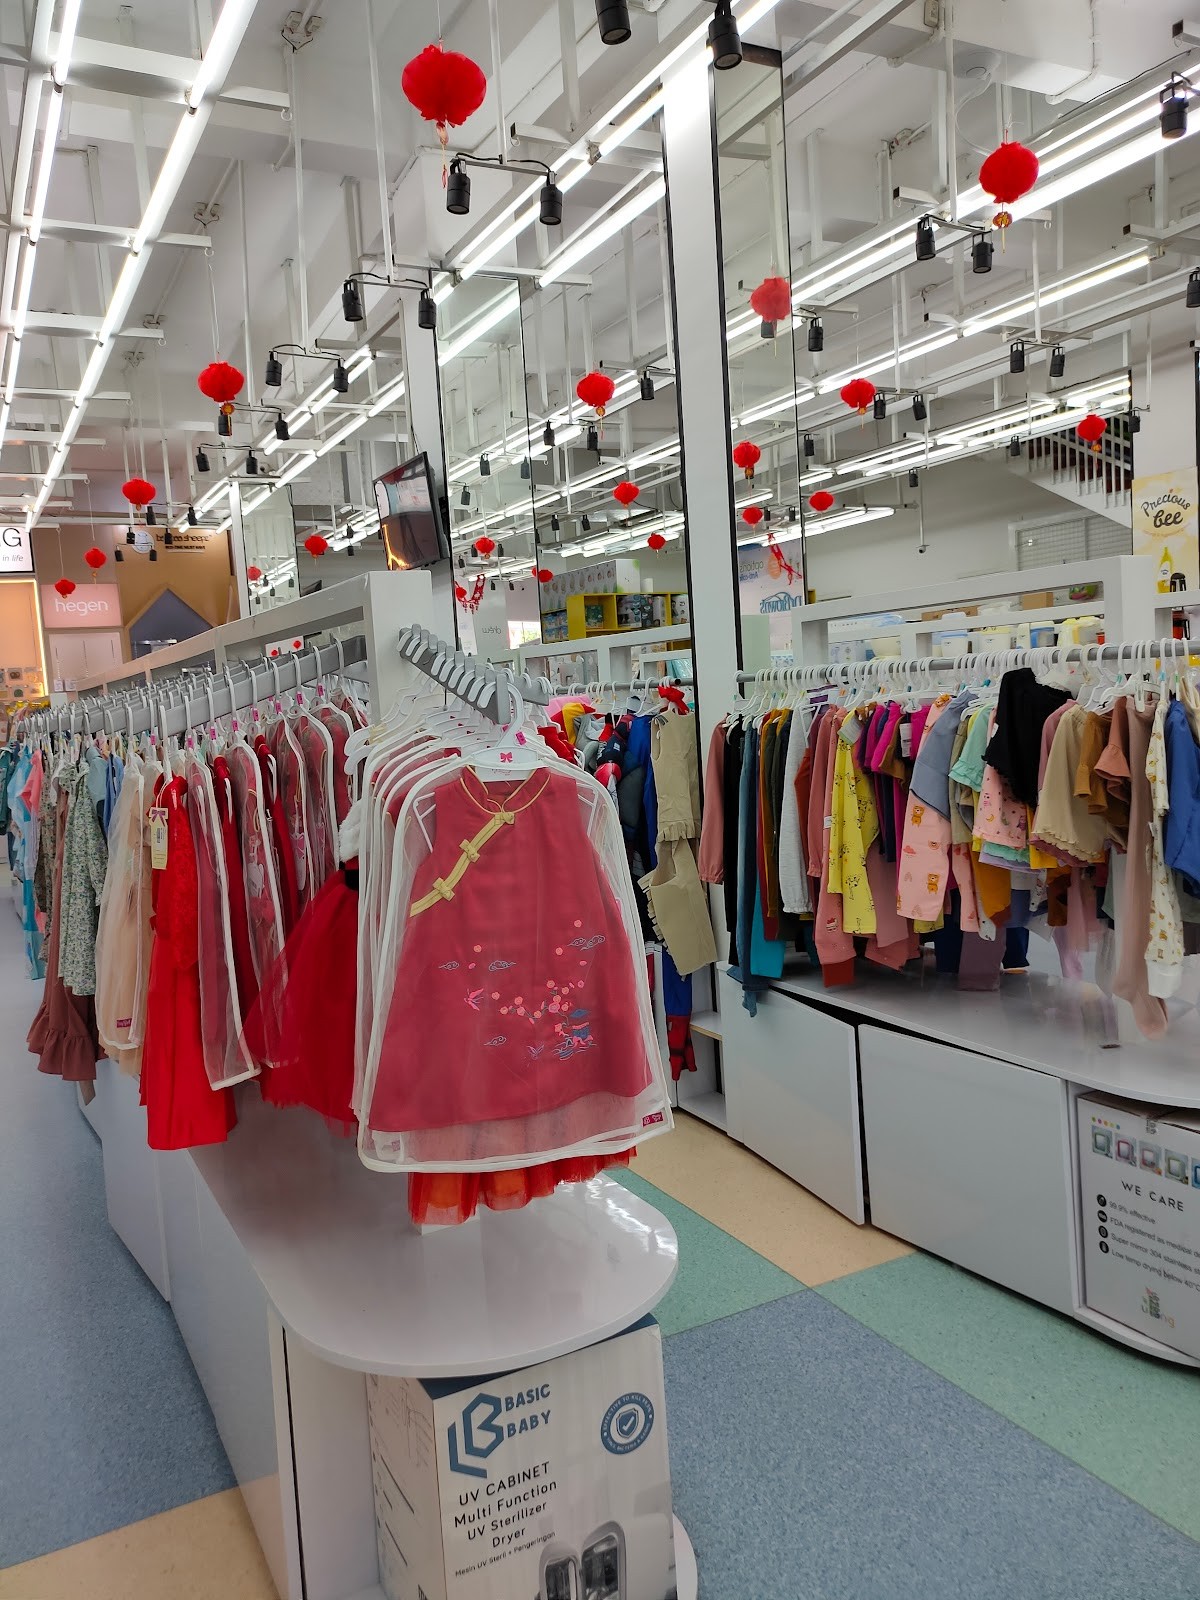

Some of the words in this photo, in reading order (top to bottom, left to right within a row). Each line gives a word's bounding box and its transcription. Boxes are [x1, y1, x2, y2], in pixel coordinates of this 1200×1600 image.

[1141, 494, 1191, 517] Precious
[2, 554, 10, 562] in
[11, 554, 24, 562] life
[54, 598, 109, 616] hegen
[1121, 1180, 1142, 1198] WE
[1150, 1191, 1184, 1212] CARE
[1109, 1200, 1128, 1214] 99.9%
[1129, 1207, 1156, 1225] effective
[1110, 1216, 1124, 1229] FDA
[1125, 1222, 1156, 1242] registered
[1166, 1237, 1192, 1255] medical
[1111, 1232, 1129, 1247] Super
[1129, 1238, 1148, 1252] mirror
[1149, 1246, 1162, 1260] 304
[1163, 1254, 1193, 1273] stainless
[1112, 1249, 1125, 1261] Low
[1125, 1254, 1142, 1268] temp
[1142, 1261, 1163, 1279] drying
[1163, 1268, 1183, 1285] below
[504, 1383, 551, 1412] BASIC
[507, 1409, 552, 1438] BABY
[458, 1488, 480, 1507] UV
[485, 1461, 551, 1497] CABINET
[454, 1506, 492, 1529] Multi
[497, 1480, 558, 1512] Function
[467, 1524, 487, 1541] UV
[491, 1501, 548, 1532] Sterilizer
[492, 1527, 526, 1549] Dryer
[455, 1564, 476, 1578] Mesin
[477, 1558, 488, 1569] UV
[513, 1531, 556, 1553] Pengeringan
